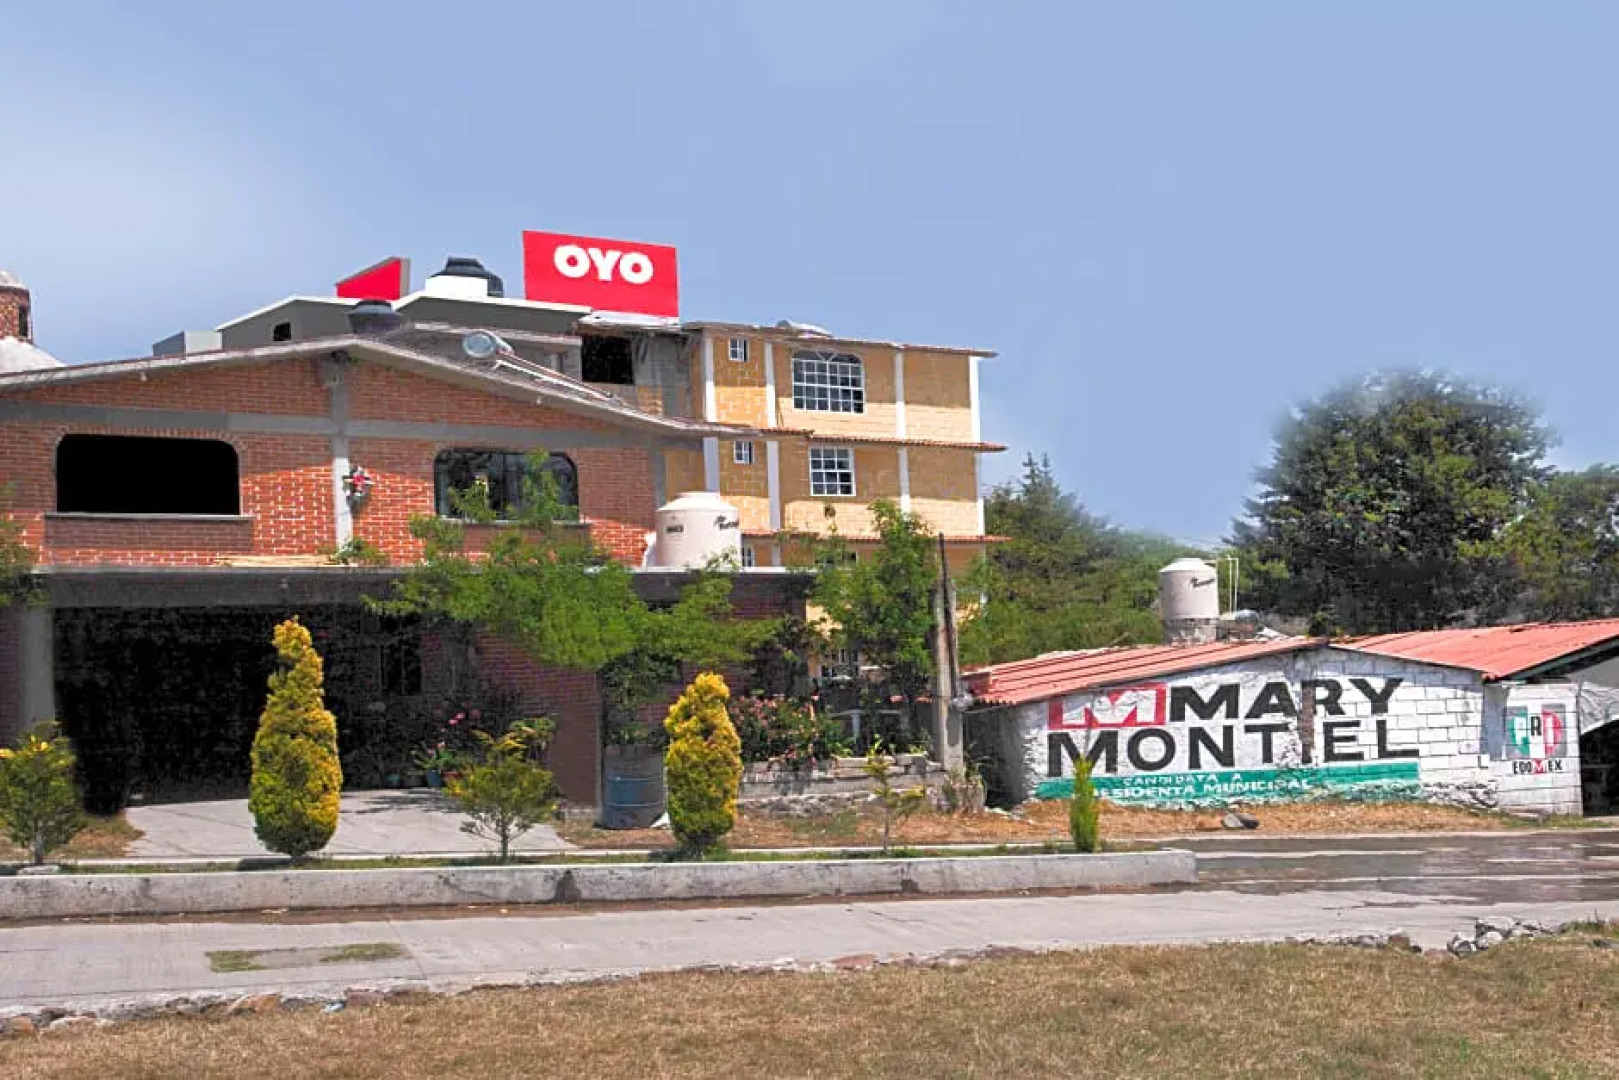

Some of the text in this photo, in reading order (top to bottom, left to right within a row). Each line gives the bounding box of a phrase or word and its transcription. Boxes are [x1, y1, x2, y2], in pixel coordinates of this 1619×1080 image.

[554, 244, 653, 284] OYO
[1170, 677, 1403, 722] MARY
[1047, 720, 1420, 777] MONTIEL
[1513, 758, 1563, 774] EDOMEX
